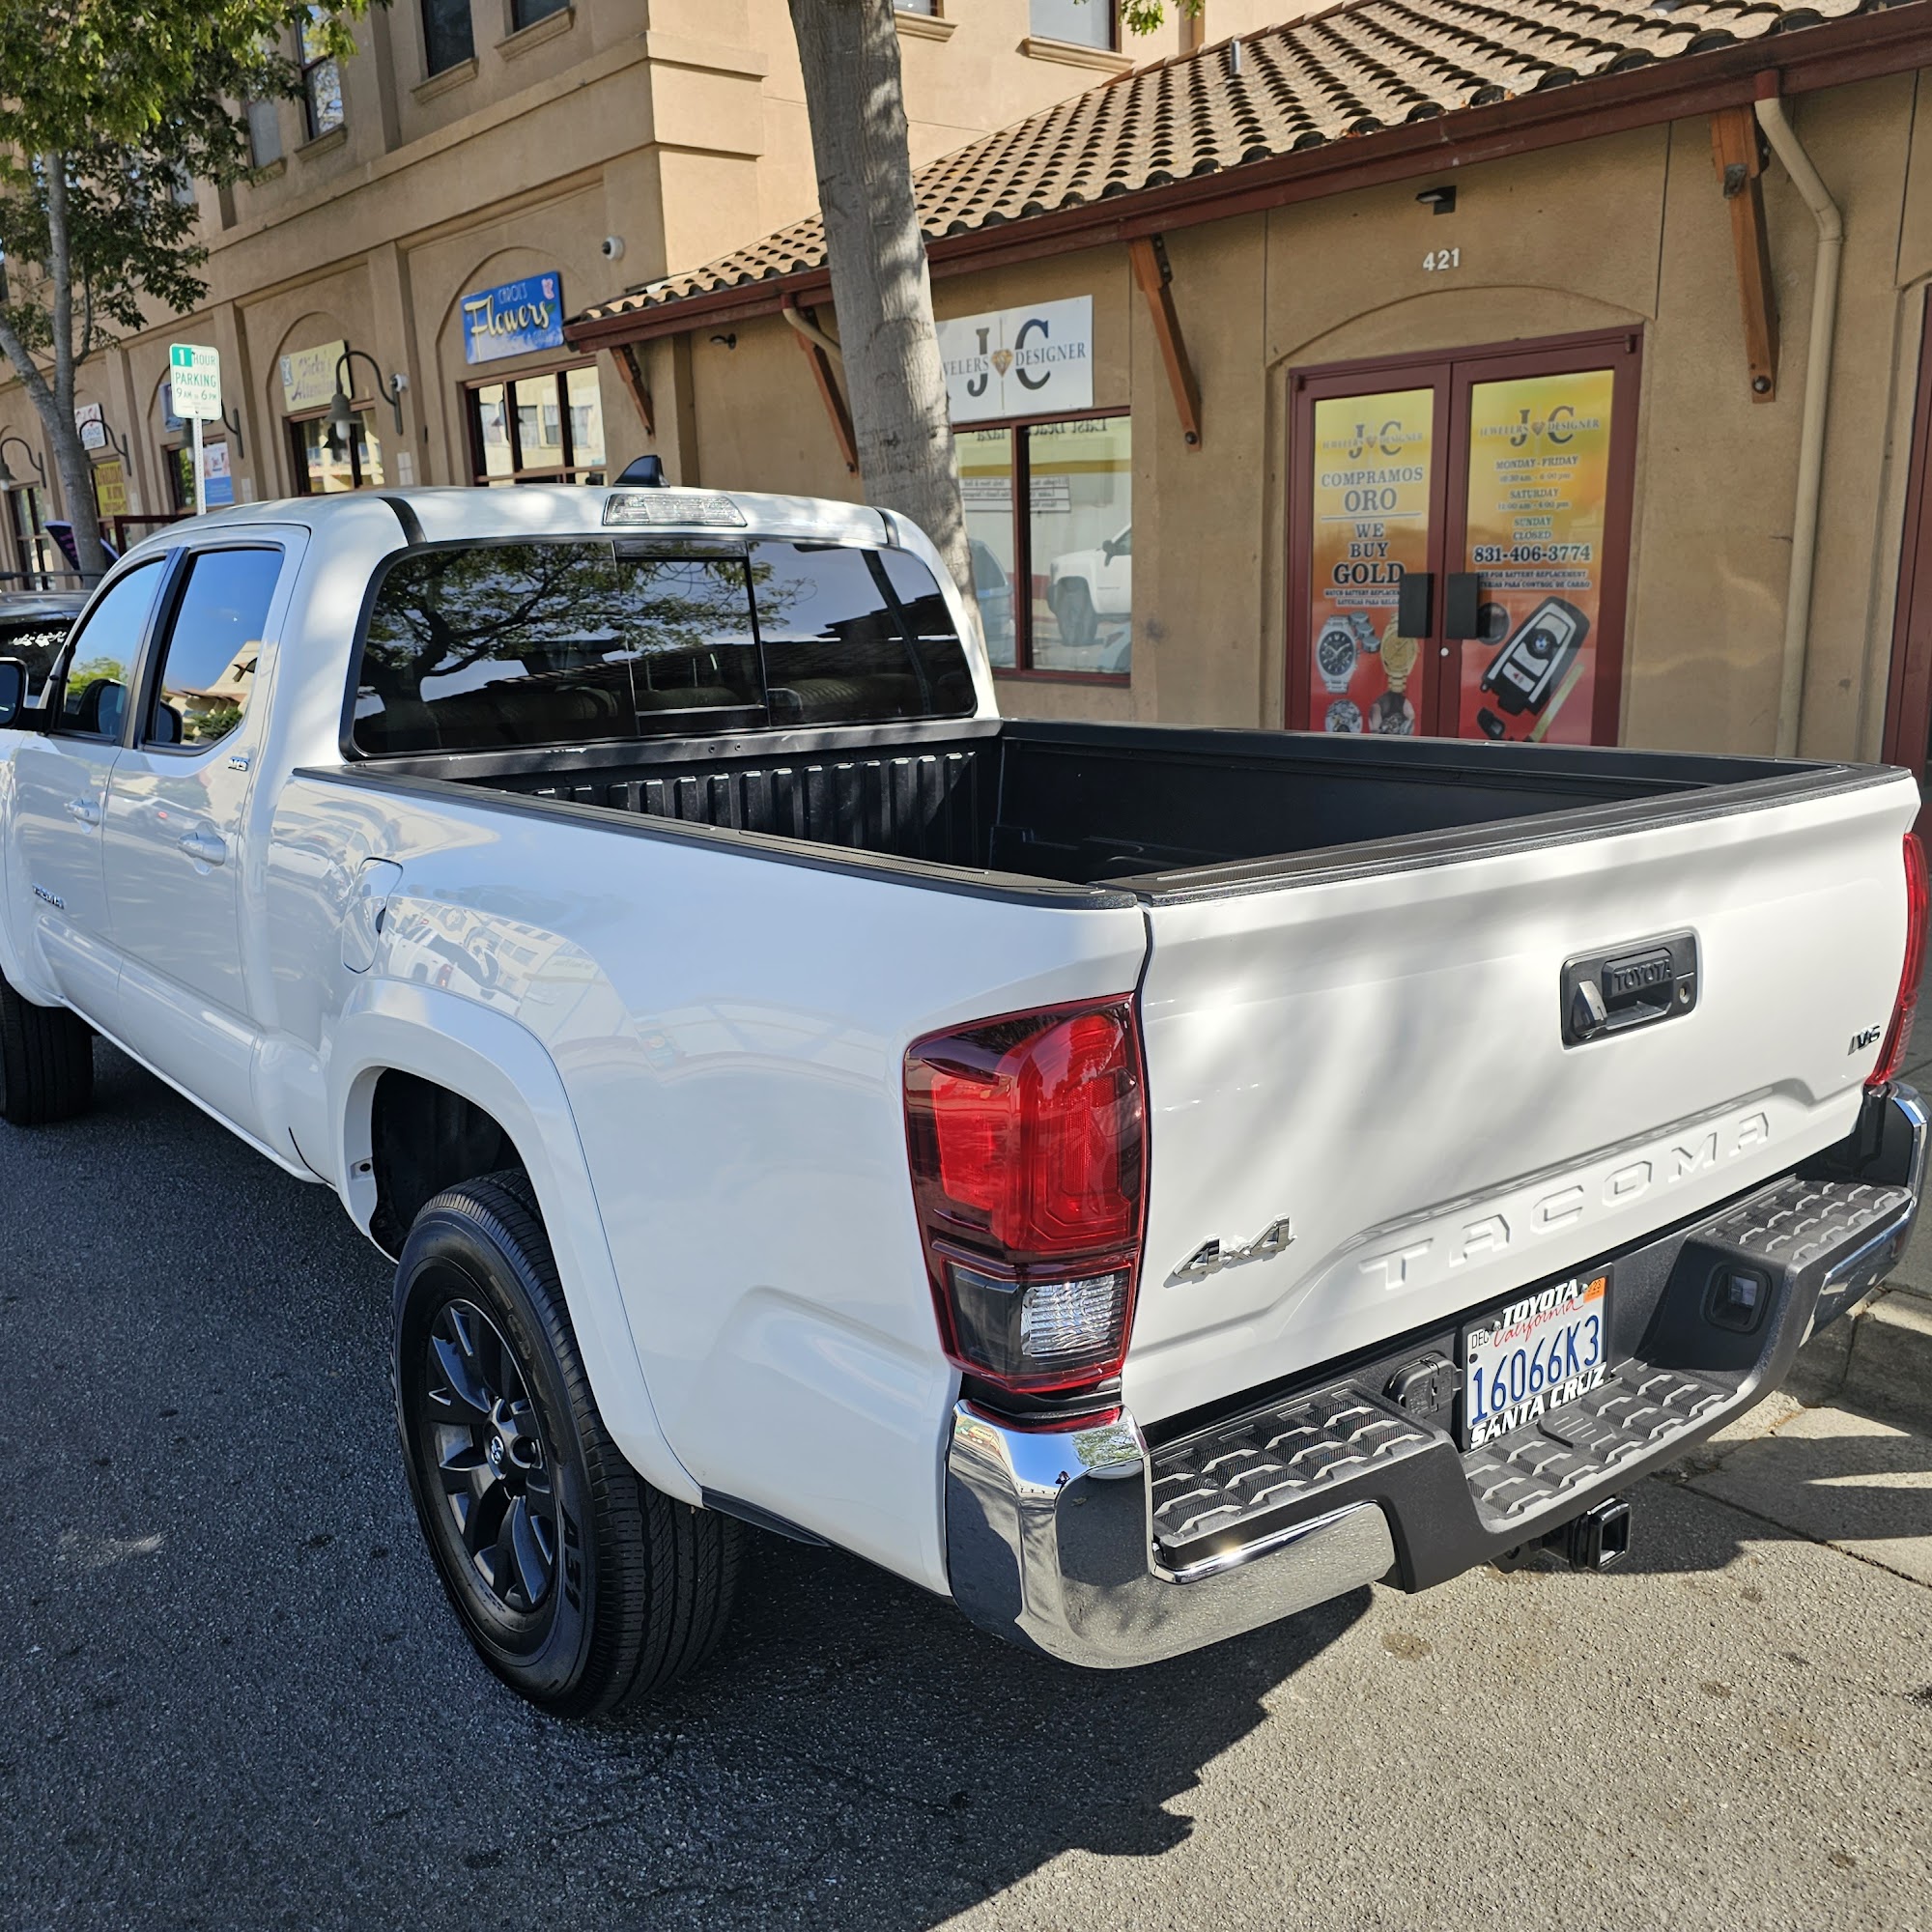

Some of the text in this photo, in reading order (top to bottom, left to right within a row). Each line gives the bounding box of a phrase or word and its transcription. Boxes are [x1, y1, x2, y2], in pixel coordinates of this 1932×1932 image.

[1423, 247, 1460, 270] 421
[464, 294, 550, 361] Flowers
[179, 349, 216, 365] 1 HOUR
[966, 318, 1052, 397] J C
[1015, 341, 1087, 366] DESIGNER
[175, 372, 216, 387] PARKING
[176, 387, 183, 398] 9
[201, 389, 208, 401] 6
[1548, 418, 1600, 432] DESIGNER
[1496, 458, 1536, 469] MONDAY
[1542, 456, 1578, 468] FRIDAY
[1321, 467, 1424, 487] COMPRAMOS
[1344, 488, 1398, 512] ORO
[1510, 488, 1559, 499] SATURDAY
[1354, 523, 1384, 539] WE
[1514, 517, 1552, 526] SUNDAY
[1513, 531, 1551, 541] CLOSED
[1350, 541, 1389, 558] BUY
[1473, 544, 1591, 563] 831-406-3774
[1333, 562, 1405, 584] GOLD
[1613, 958, 1672, 991] TOYOTA
[1359, 1111, 1770, 1291] TACOMA
[1502, 1278, 1579, 1328] TOYOTA
[1494, 1298, 1583, 1348] California
[1471, 1330, 1490, 1350] DEC
[1471, 1315, 1600, 1425] 16066K3
[1470, 1362, 1606, 1449] SANTA CRUZ
